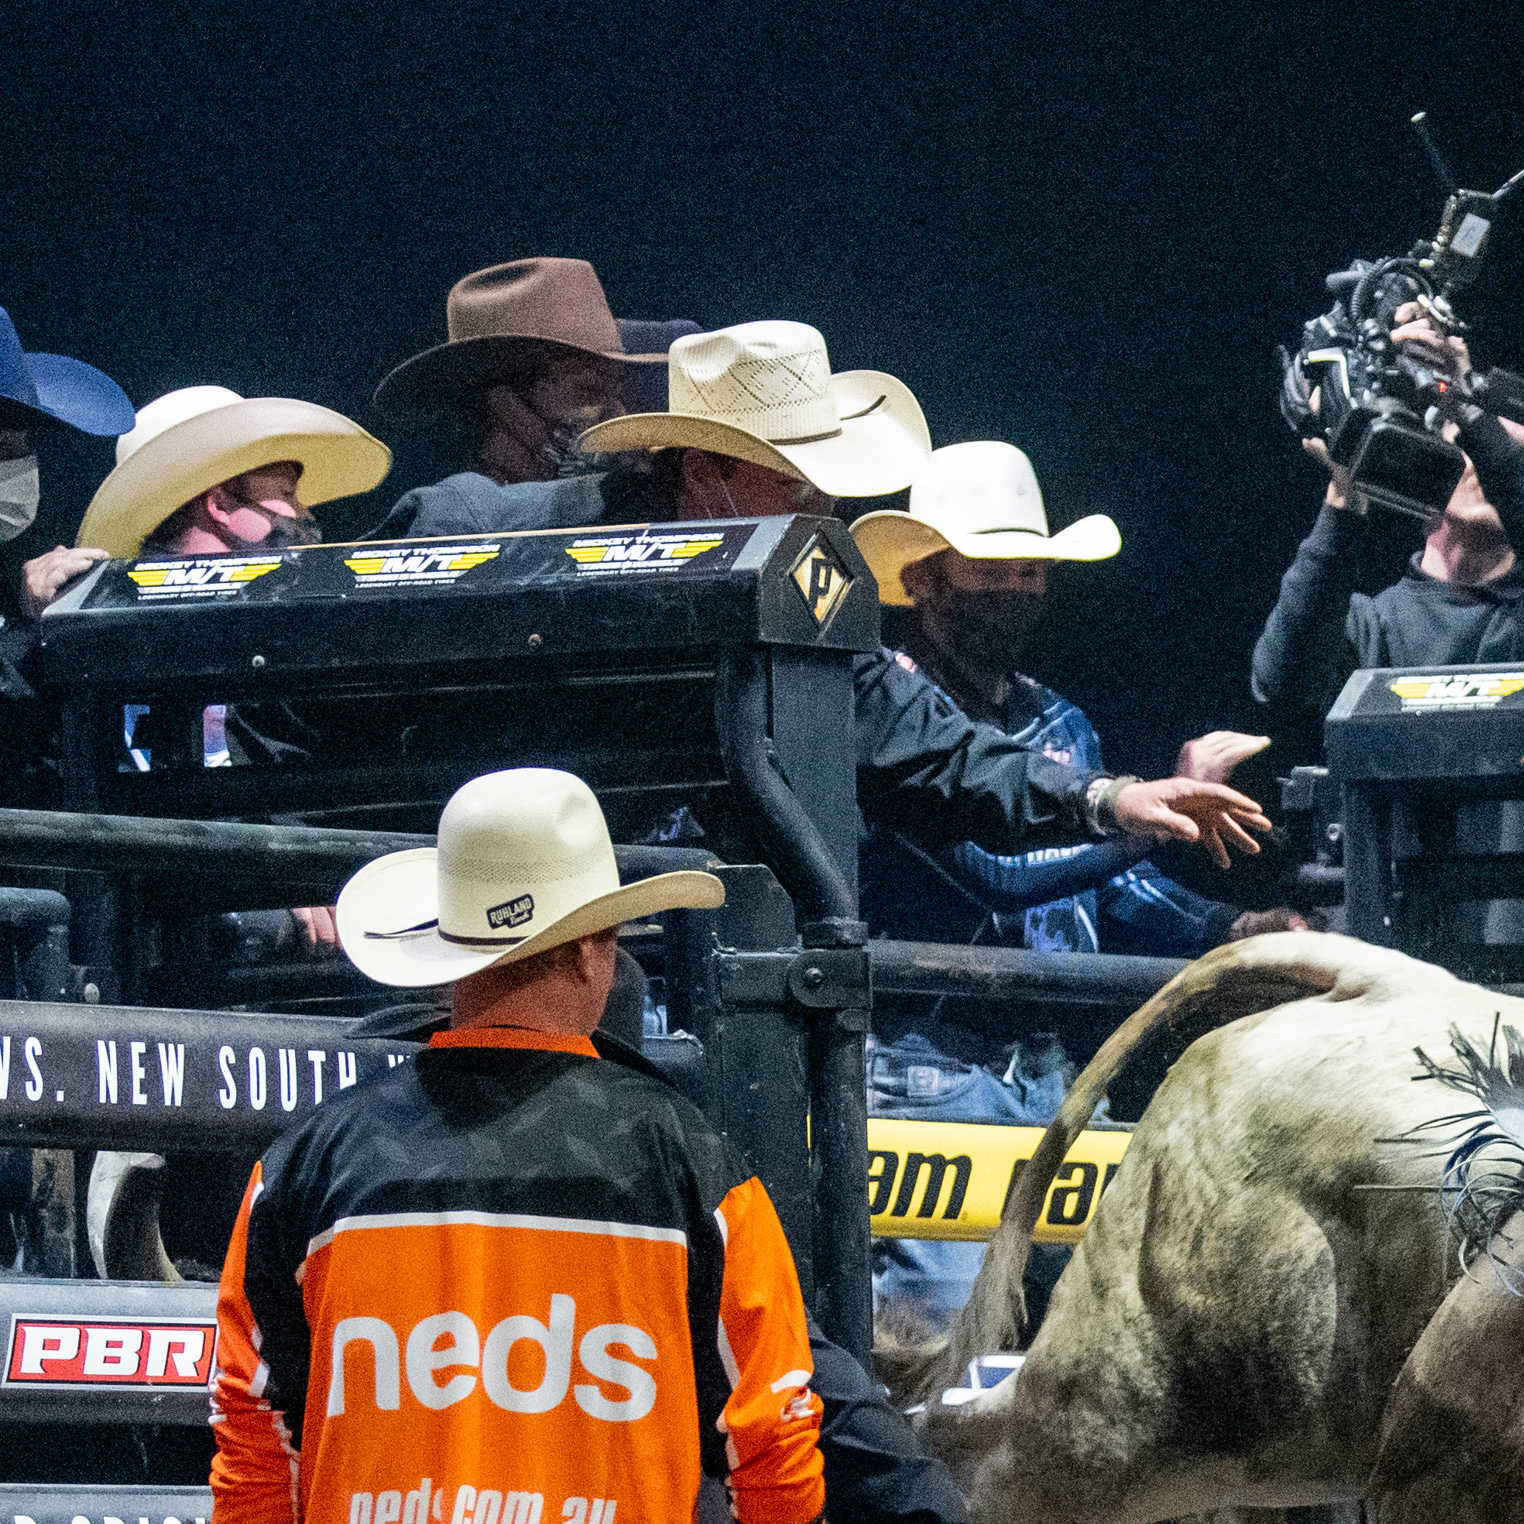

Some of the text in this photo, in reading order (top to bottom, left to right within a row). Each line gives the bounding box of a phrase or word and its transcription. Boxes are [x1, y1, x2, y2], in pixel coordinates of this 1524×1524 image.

[381, 554, 464, 573] M/T
[603, 542, 686, 561] M/T
[164, 566, 246, 586] M/T
[97, 1039, 185, 1107] NEW
[218, 1045, 357, 1112] SOUTH
[20, 1326, 204, 1379] PBR
[327, 1293, 658, 1422] neds
